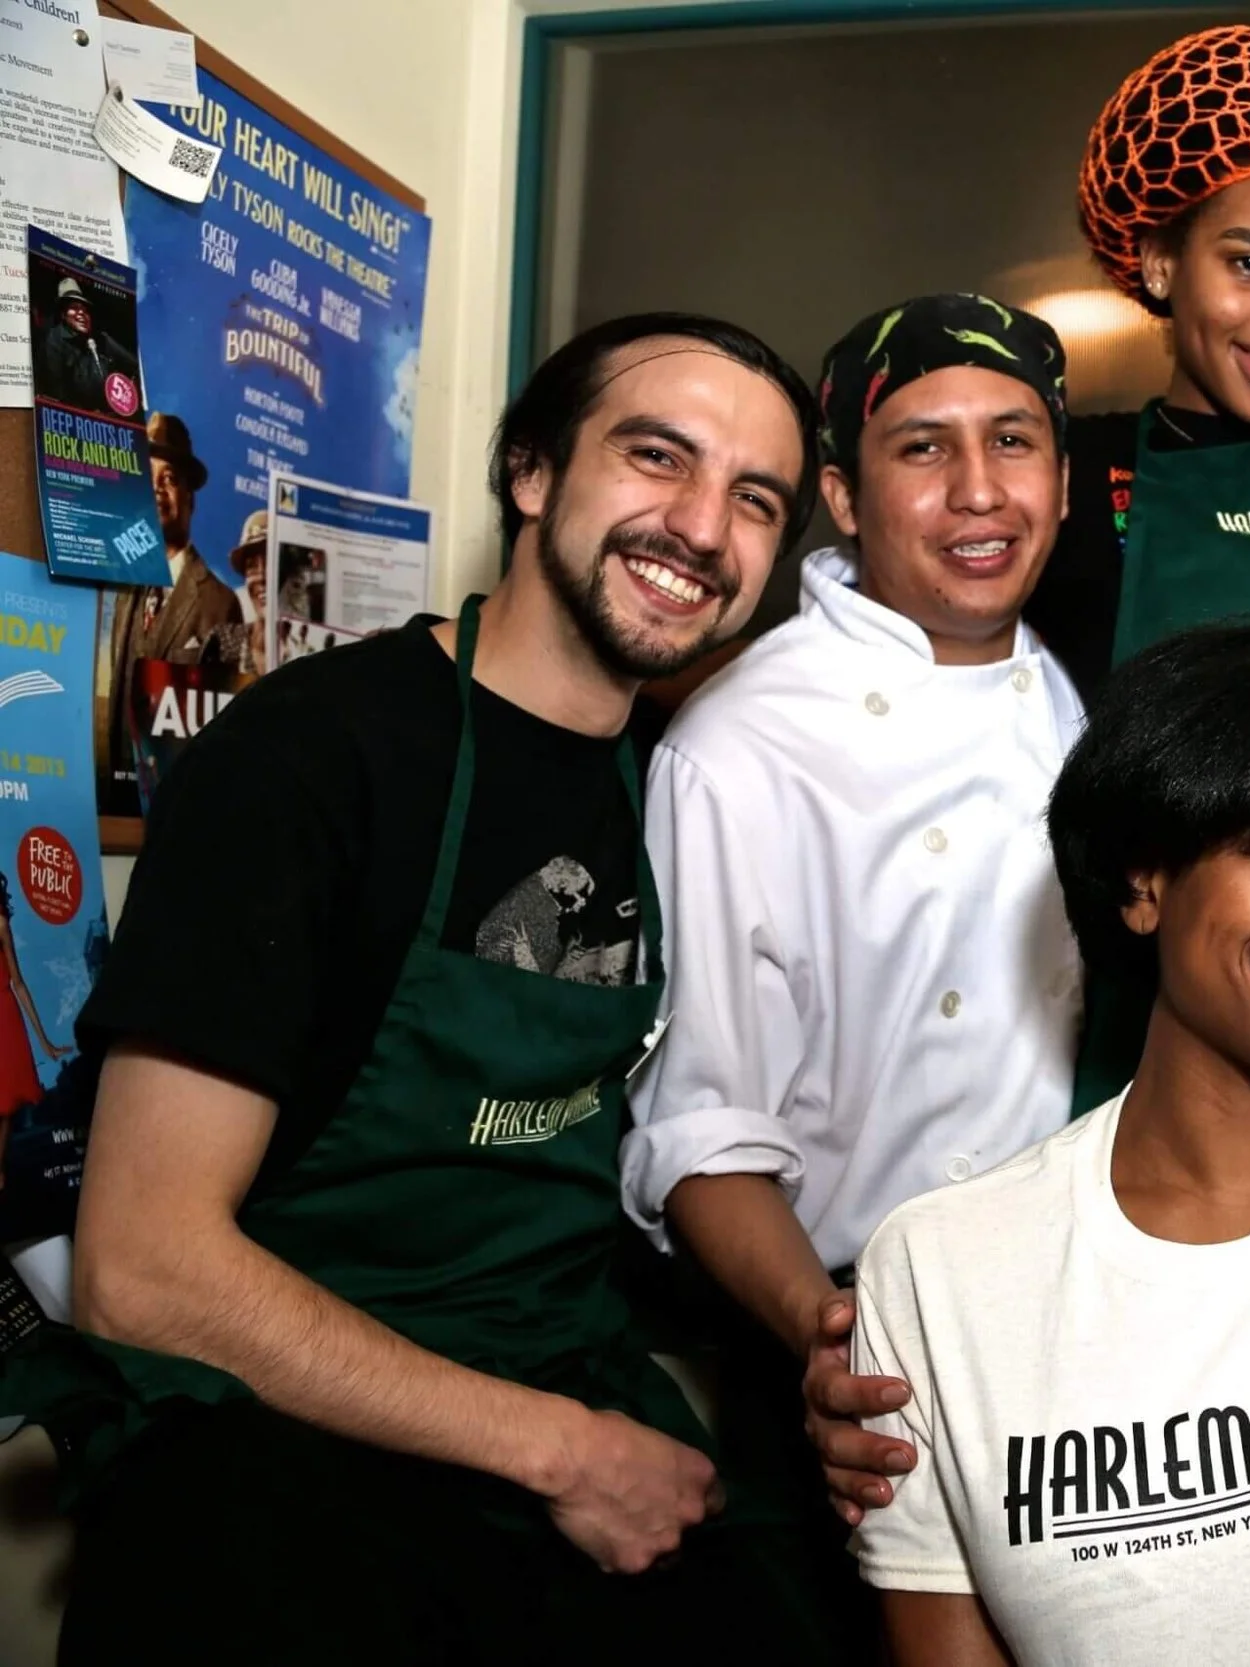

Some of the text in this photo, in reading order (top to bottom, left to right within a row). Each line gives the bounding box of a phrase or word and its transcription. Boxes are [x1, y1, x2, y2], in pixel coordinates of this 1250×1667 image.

[234, 117, 299, 190] HEART
[302, 161, 344, 221] WILL
[202, 220, 239, 255] CICELY
[232, 181, 285, 237] TYSON
[287, 219, 325, 260] ROCKS
[202, 241, 237, 277] TYSON
[263, 308, 299, 339] TRIP
[226, 329, 325, 404] BOUNTIFUL
[43, 406, 134, 451] DEEP ROOTS OF
[44, 431, 80, 462] ROCK
[82, 441, 108, 468] AND
[110, 448, 143, 476] ROLL
[30, 836, 61, 868] FREE
[31, 863, 73, 901] PUBLIC
[1071, 1545, 1099, 1562] 100
[1103, 1542, 1119, 1558] W
[1125, 1534, 1172, 1556] 124TH
[1177, 1530, 1198, 1546] ST,
[1201, 1519, 1237, 1541] NEW
